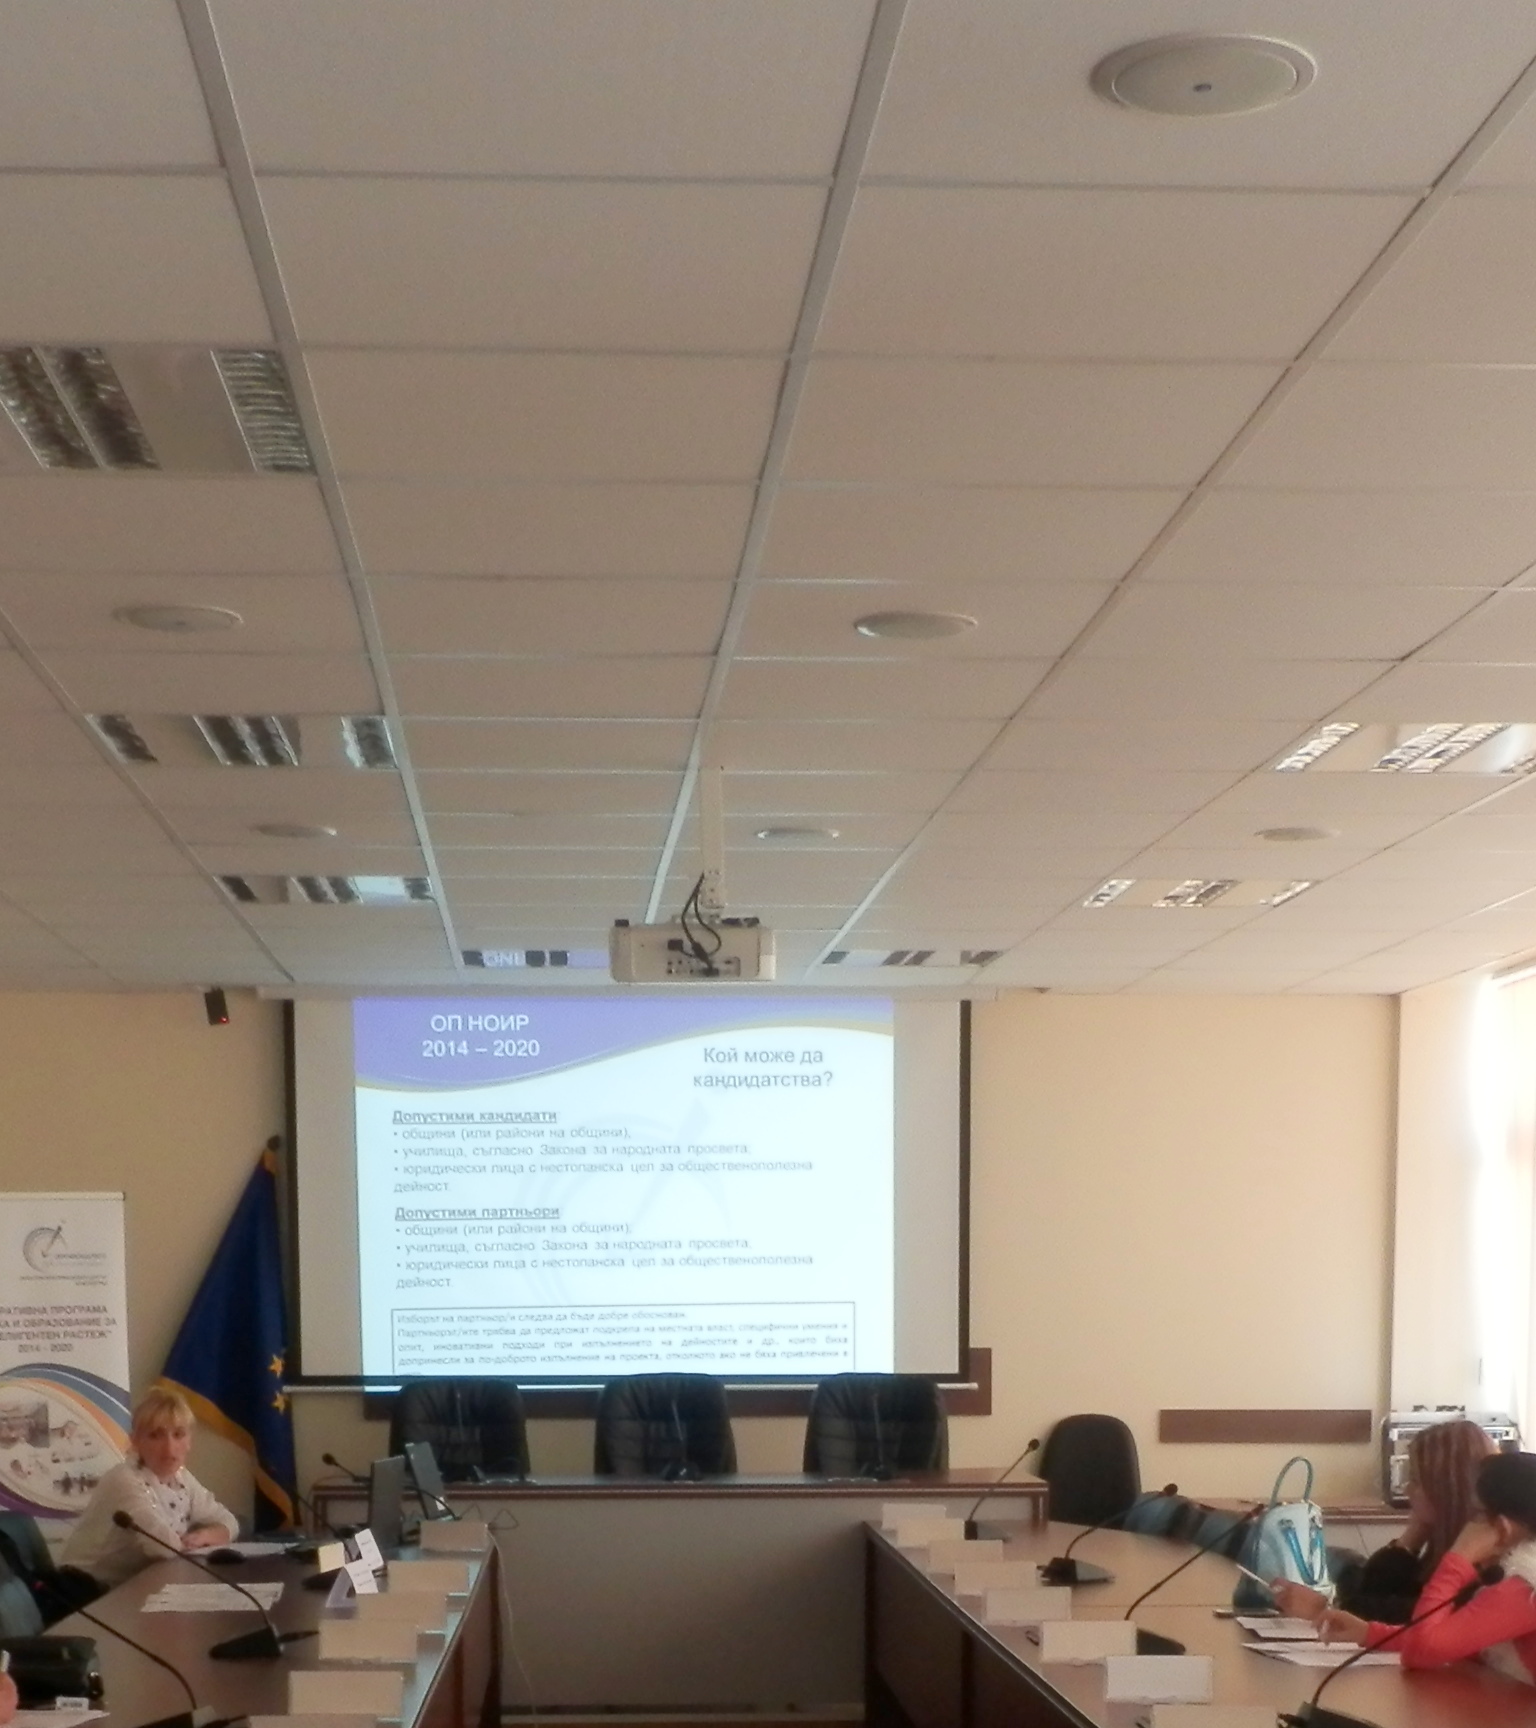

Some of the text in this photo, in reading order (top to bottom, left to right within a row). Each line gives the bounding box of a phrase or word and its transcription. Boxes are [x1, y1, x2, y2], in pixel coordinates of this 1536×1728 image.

[431, 1015, 529, 1032] ОП НОИР
[422, 1040, 469, 1057] 2014
[493, 1040, 540, 1057] 2020
[704, 1048, 823, 1065] Кой може да
[693, 1071, 833, 1089] кандидатства?
[393, 1110, 557, 1124] Допустими кандидати
[402, 1128, 455, 1142] общини
[461, 1128, 491, 1141] (или
[496, 1128, 544, 1142] райони
[550, 1129, 564, 1138] на
[472, 1147, 533, 1158] съгласно
[540, 1144, 586, 1155] Закона
[593, 1146, 607, 1155] за
[612, 1145, 680, 1157] народната
[403, 1160, 813, 1176] юридически лица с нестопанска цел за общественополезна
[395, 1206, 560, 1221] Допустими партньори
[405, 1225, 457, 1238] общини
[463, 1225, 492, 1237] (или
[498, 1224, 546, 1237] райони
[551, 1225, 566, 1233] на
[475, 1242, 535, 1253] съгласно
[542, 1240, 588, 1250] Закона
[595, 1242, 608, 1250] за
[613, 1240, 682, 1252] народната
[406, 1255, 813, 1272] юридически лица с нестопанска цел за общественополезна
[50, 1305, 107, 1314] ПРОГРАМА
[104, 1318, 117, 1326] ЗА
